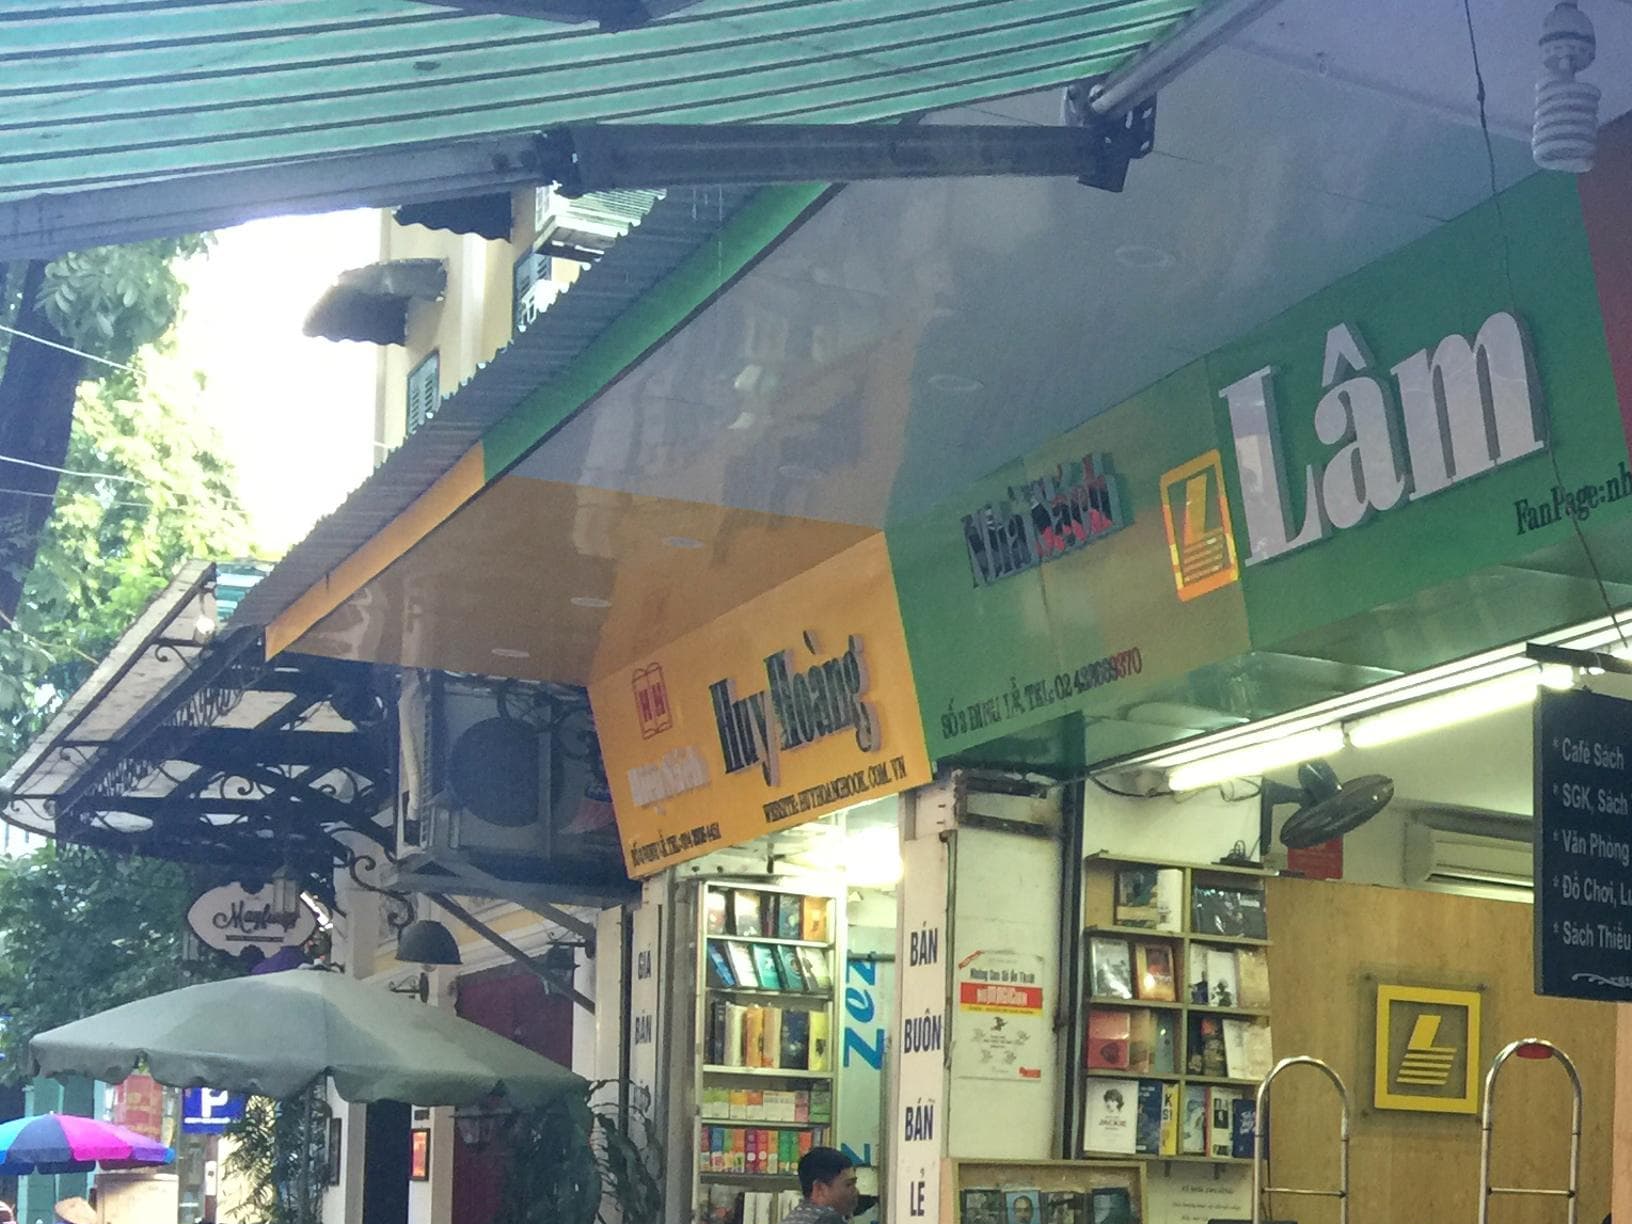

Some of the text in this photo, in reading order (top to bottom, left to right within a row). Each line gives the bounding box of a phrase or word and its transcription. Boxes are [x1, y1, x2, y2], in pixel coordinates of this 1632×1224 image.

[1217, 311, 1548, 568] Lâm
[709, 677, 782, 788] Huy
[763, 629, 882, 753] Hoàng
[1561, 736, 1625, 770] Café Sách
[1562, 783, 1595, 810] SGK,
[1598, 789, 1629, 815] Sách
[1561, 829, 1587, 854] Văn
[1589, 837, 1630, 867] Phòng
[1561, 872, 1582, 898] Đồ
[909, 920, 938, 967] BÁN
[1562, 919, 1594, 947] Sách
[903, 1007, 942, 1054] BUÔN
[904, 1097, 935, 1142] BÁN
